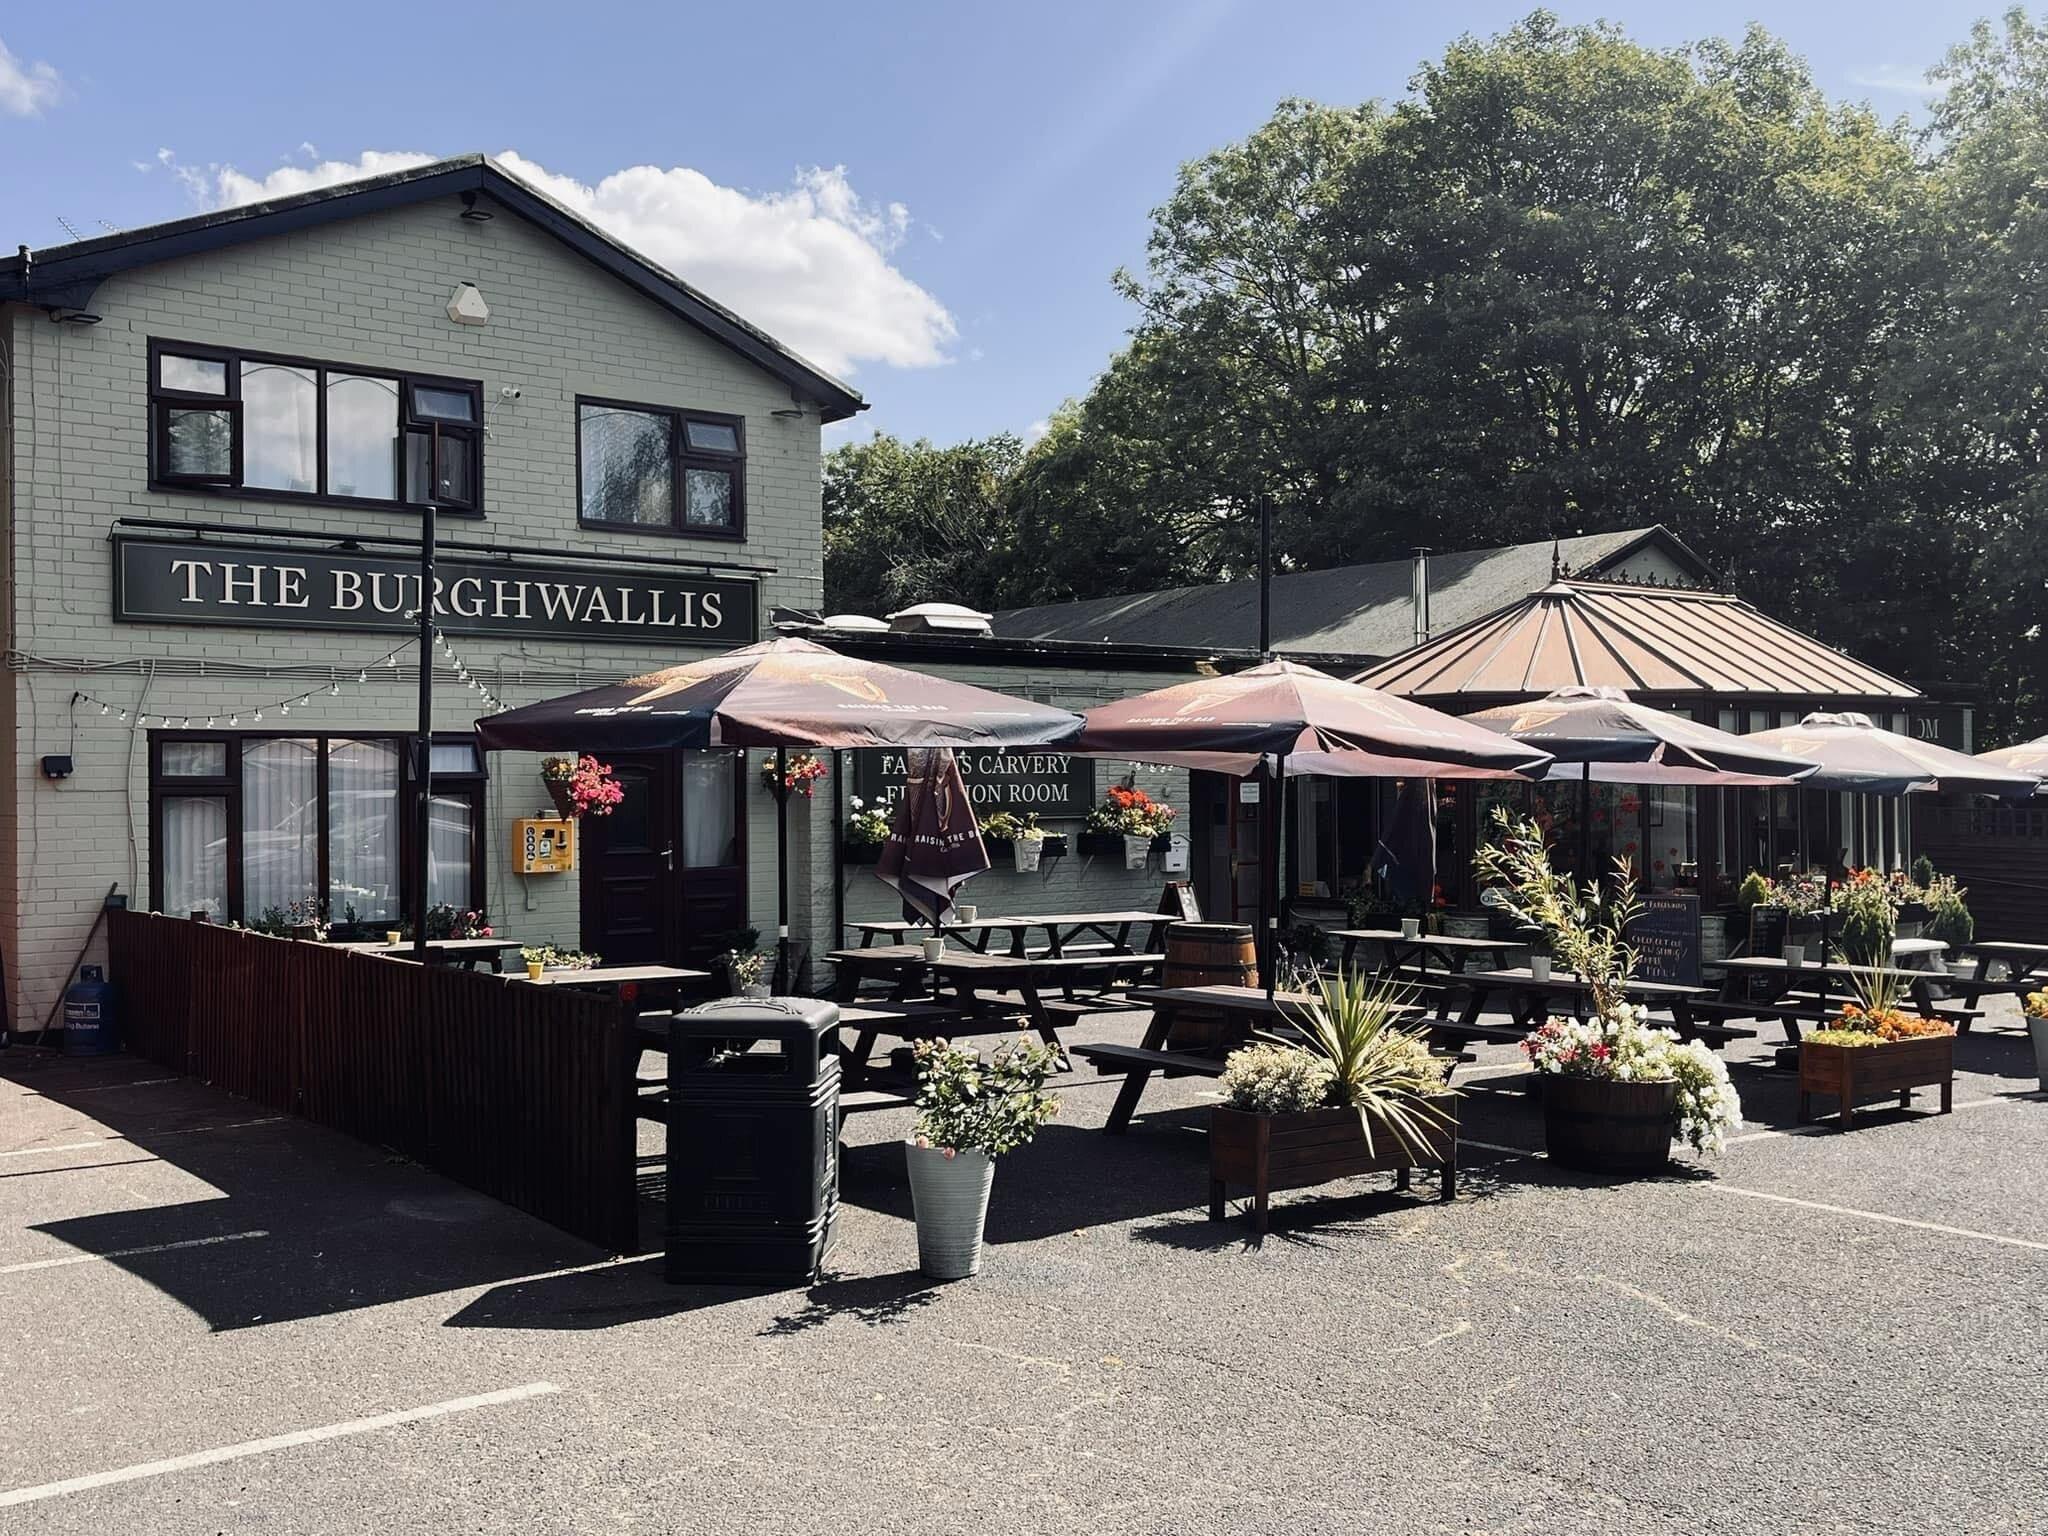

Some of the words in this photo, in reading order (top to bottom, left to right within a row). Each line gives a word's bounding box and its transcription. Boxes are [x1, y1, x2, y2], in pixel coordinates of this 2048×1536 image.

[170, 559, 310, 608] THE
[329, 569, 722, 630] BURGHWALLIS
[978, 755, 1072, 775] CARVERY
[1008, 784, 1070, 803] ROOM
